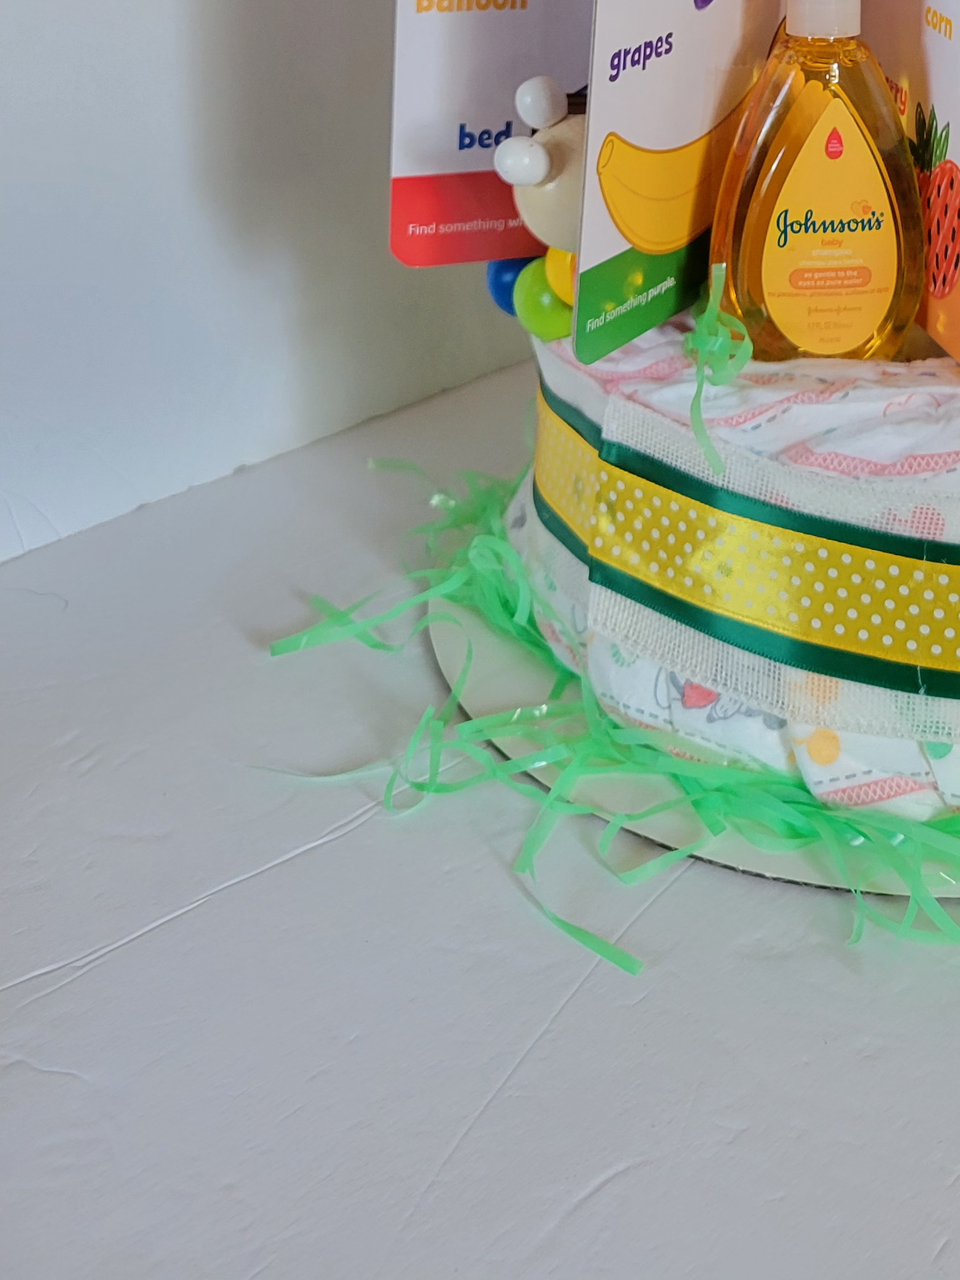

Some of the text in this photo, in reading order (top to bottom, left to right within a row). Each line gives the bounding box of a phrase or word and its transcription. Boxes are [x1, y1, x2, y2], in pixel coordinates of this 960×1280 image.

[925, 6, 953, 41] corn
[608, 31, 673, 83] grapes
[408, 223, 436, 236] Find
[438, 219, 505, 233] something
[821, 238, 844, 248] baby
[586, 311, 605, 333] Find
[605, 295, 647, 323] something
